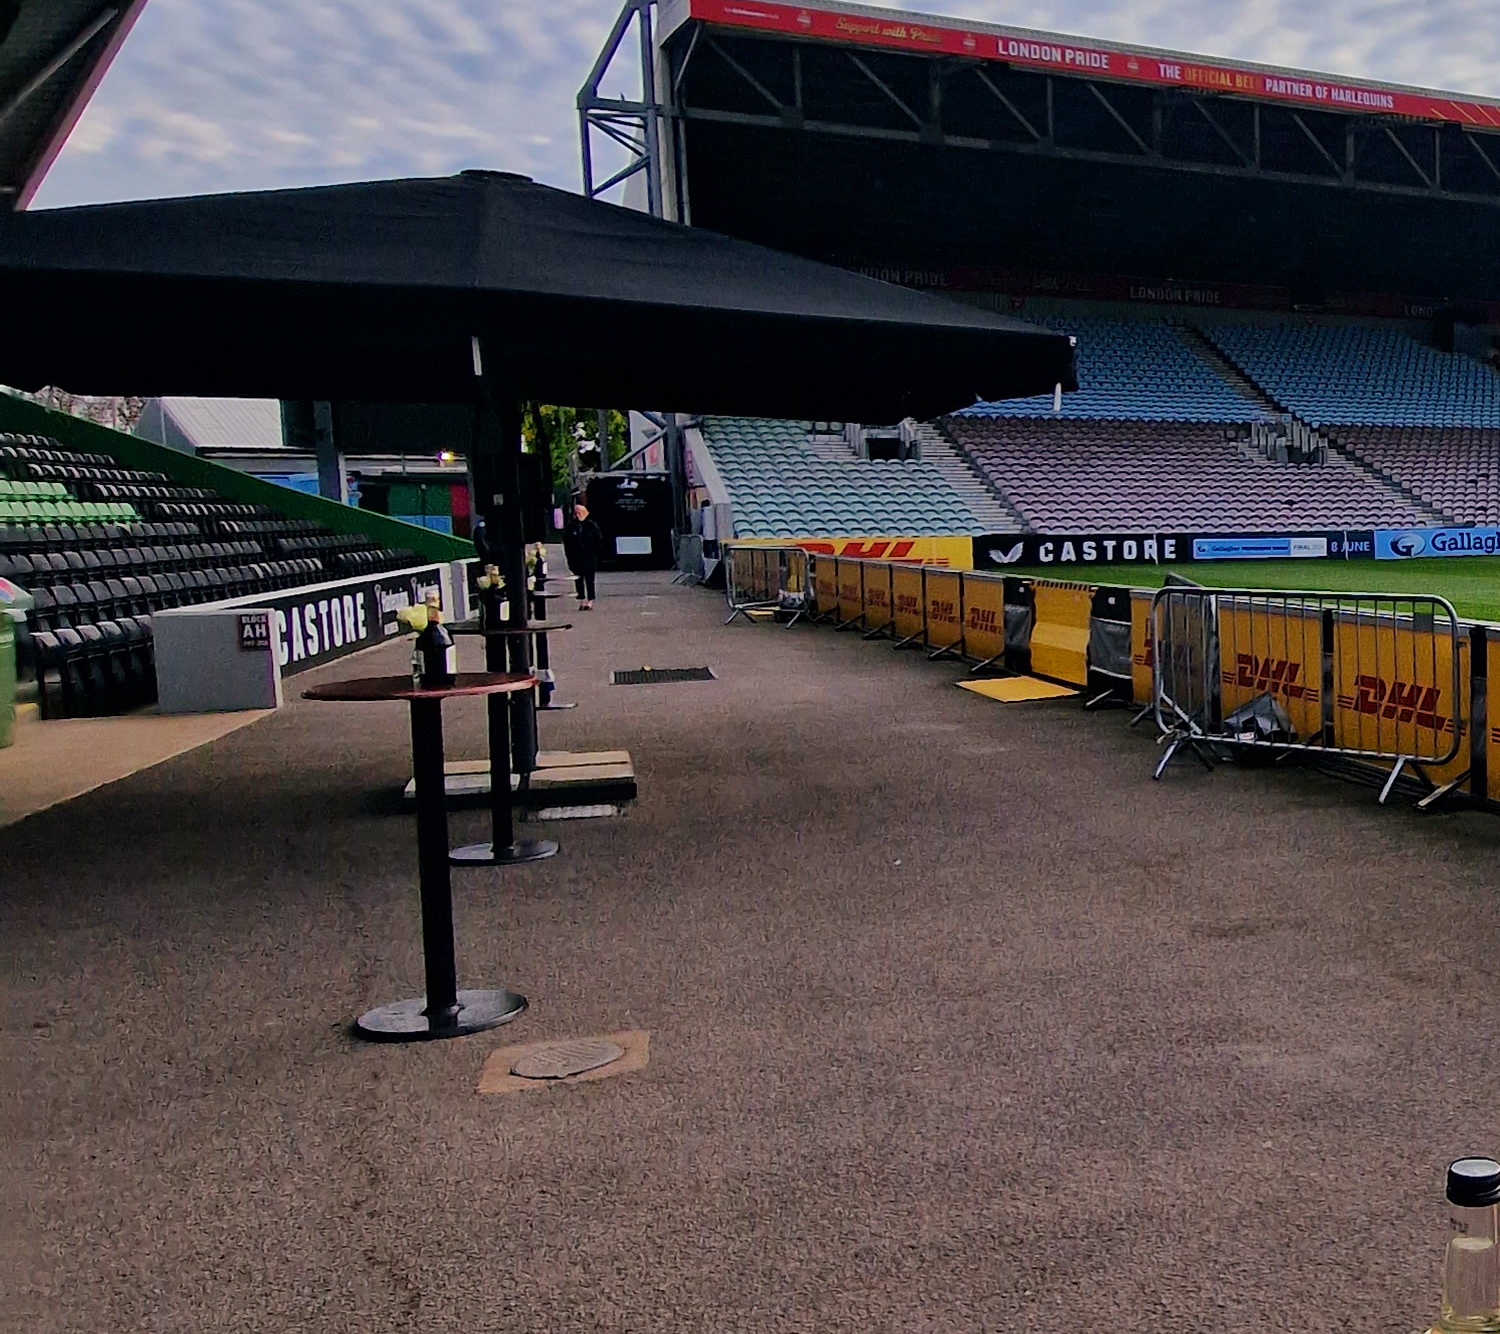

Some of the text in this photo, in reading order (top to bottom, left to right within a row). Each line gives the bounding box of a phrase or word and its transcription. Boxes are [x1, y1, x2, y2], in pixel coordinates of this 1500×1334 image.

[834, 16, 880, 36] Support
[883, 26, 907, 39] with
[998, 39, 1110, 69] LONDON PRIDE
[1159, 62, 1182, 80] THE
[1184, 68, 1233, 86] OFFICIAL
[1265, 78, 1313, 98] PARTNER
[1315, 86, 1329, 100] OF
[1331, 88, 1394, 109] HARLEQUINS
[1039, 539, 1177, 562] CASTORE
[1341, 540, 1371, 552] JUNE
[275, 591, 367, 666] CASTORE
[1237, 653, 1307, 699] DHL
[1353, 675, 1446, 733] DHL
